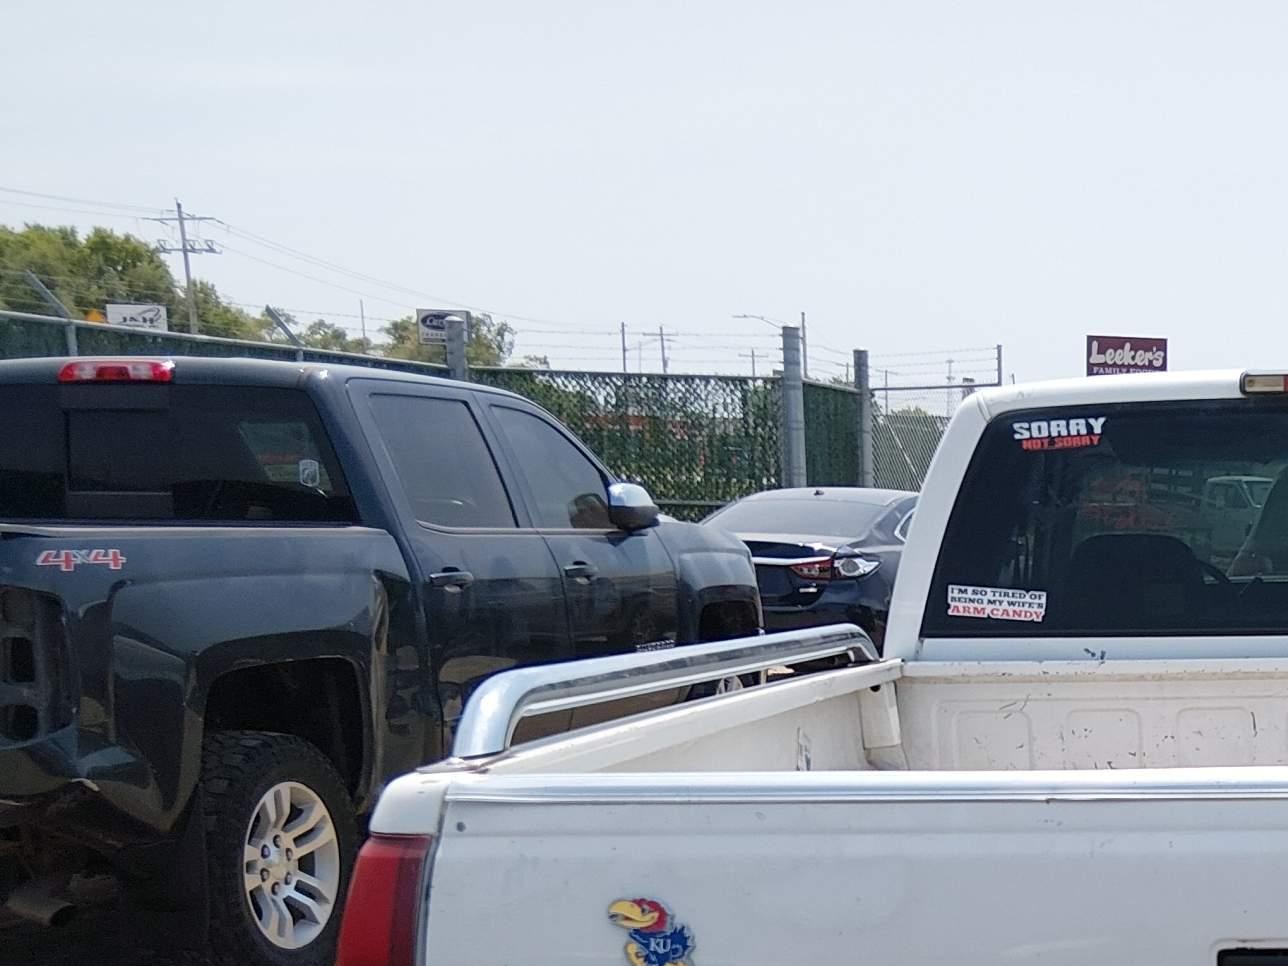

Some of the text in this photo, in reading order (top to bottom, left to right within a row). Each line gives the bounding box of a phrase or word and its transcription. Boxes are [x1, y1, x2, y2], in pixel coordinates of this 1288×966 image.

[1089, 340, 1165, 367] Leeker's
[1012, 417, 1106, 439] SORRY
[1022, 434, 1100, 450] NOT SORRY
[950, 596, 984, 604] BEING
[971, 588, 987, 596] SO
[991, 590, 1026, 599] TIRED
[951, 605, 1042, 619] ARM CANDY
[649, 937, 671, 954] KU
